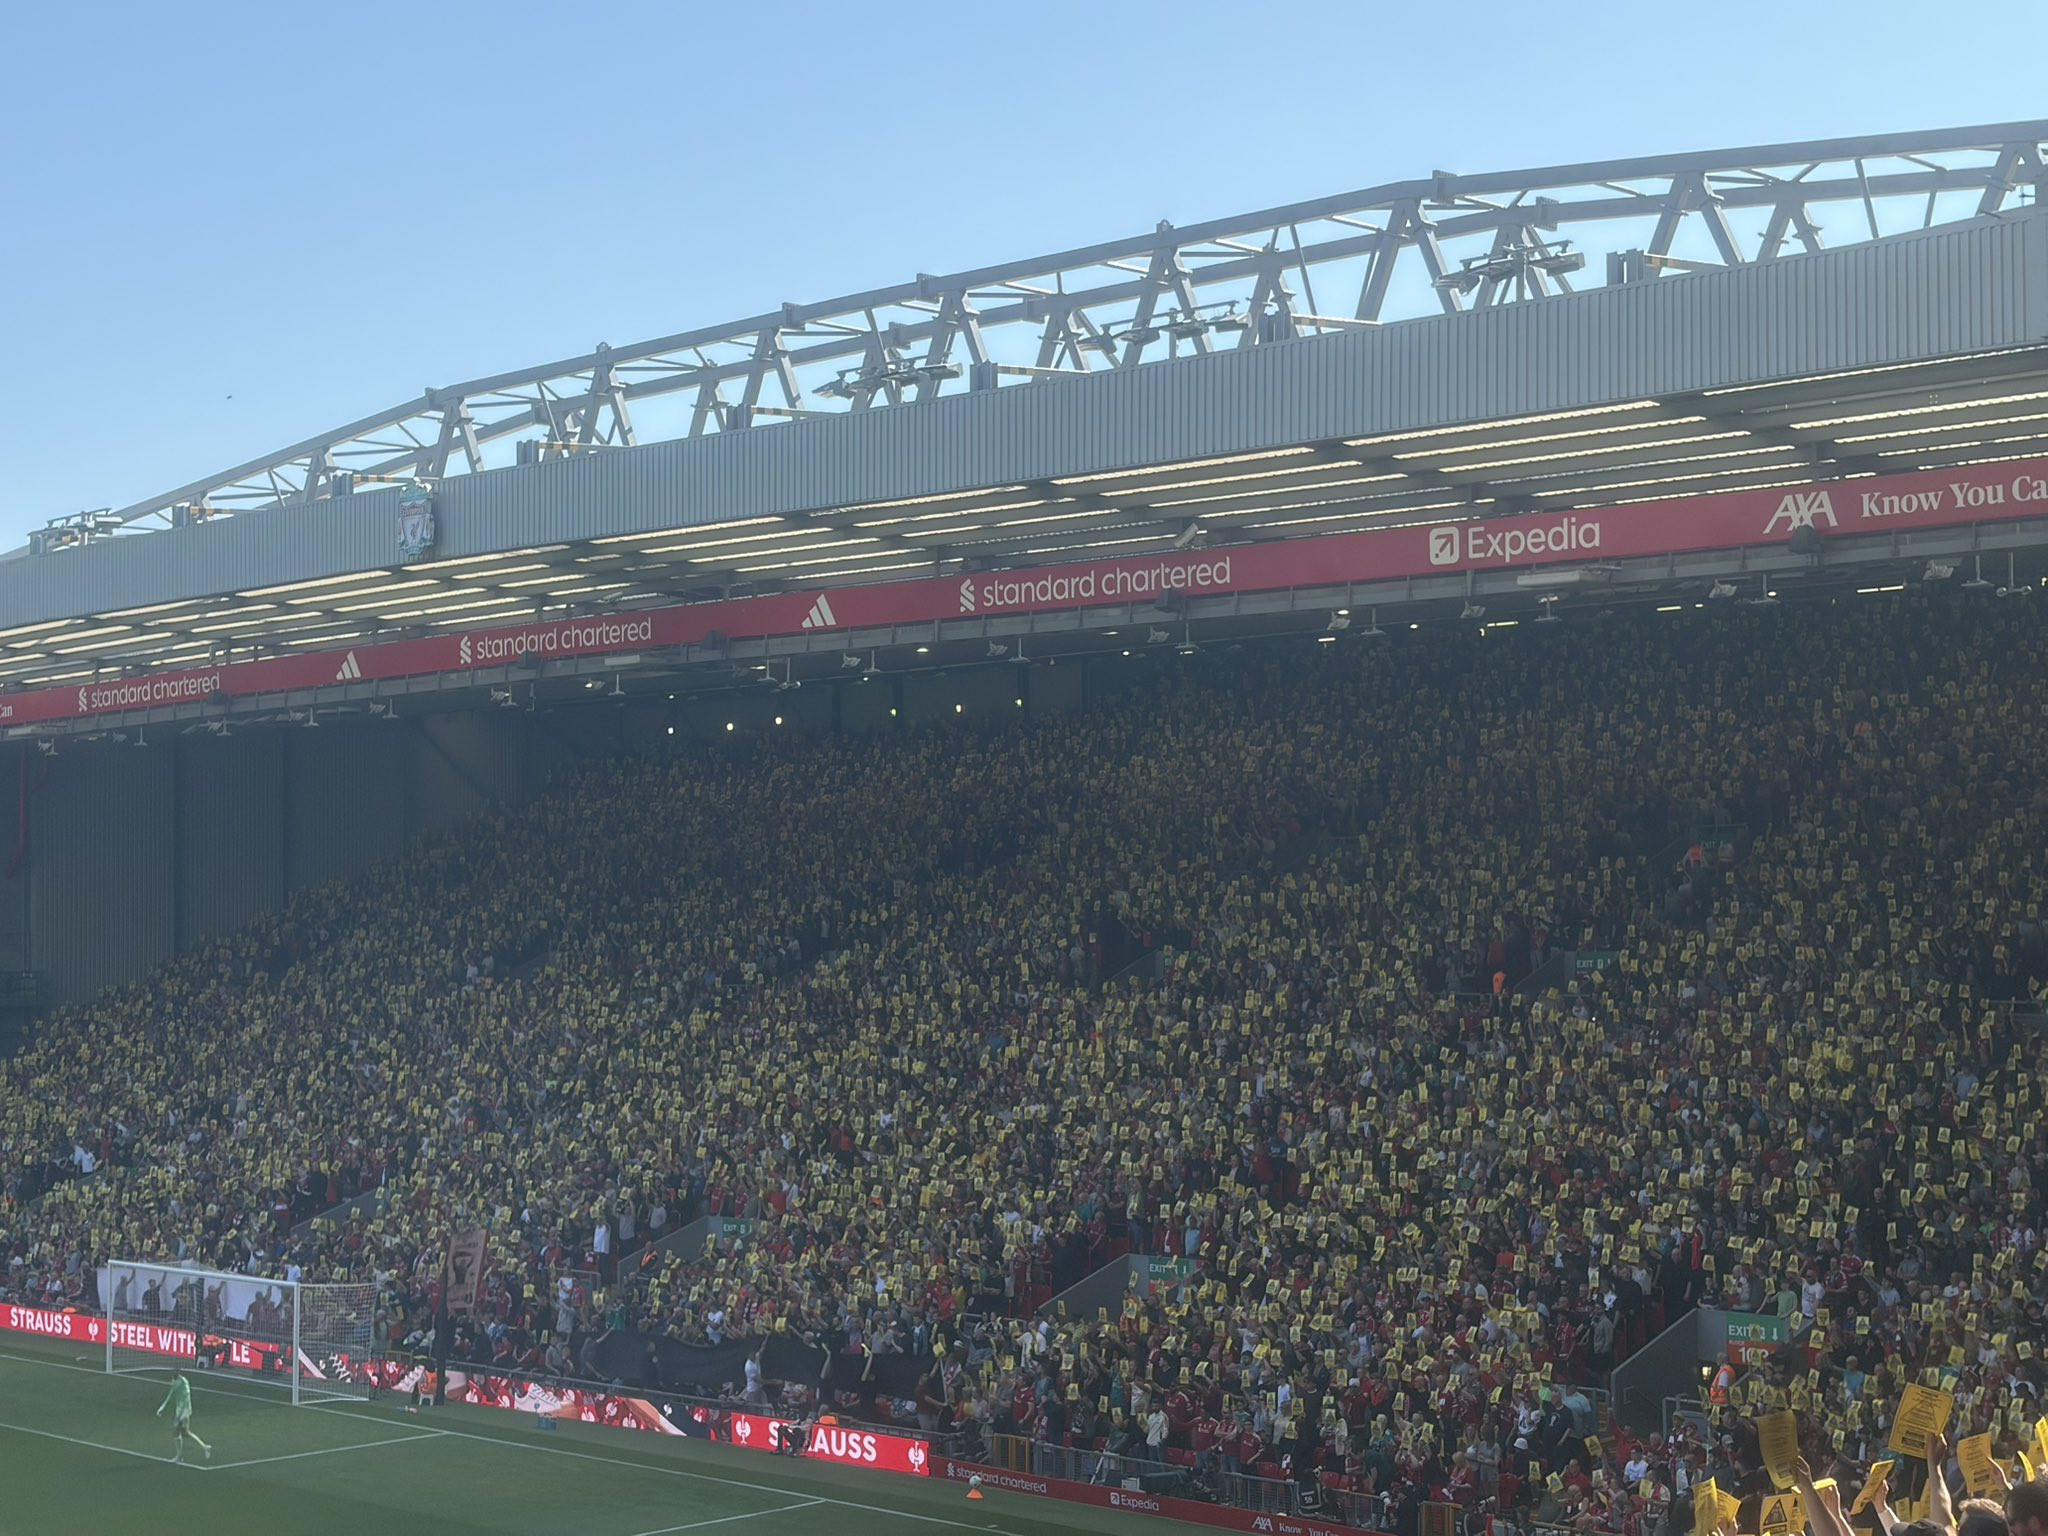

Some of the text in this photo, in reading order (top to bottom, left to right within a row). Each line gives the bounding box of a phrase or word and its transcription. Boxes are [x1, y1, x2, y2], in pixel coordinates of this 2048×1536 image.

[1763, 476, 2048, 535] AXA Know You Ca
[1468, 517, 1600, 563] Expedia
[983, 556, 1231, 607] standard chartered
[477, 617, 652, 660] standard chartered
[91, 672, 220, 708] standard chartered
[1576, 959, 1593, 969] EXIT
[1149, 1263, 1168, 1273] EXIT
[10, 1306, 71, 1336] STRAUSS
[111, 1322, 154, 1349] STEEL
[157, 1329, 197, 1356] WITH
[1000, 1476, 1047, 1493] chartered
[1121, 1494, 1160, 1511] Expedia
[1252, 1516, 1273, 1532] AXA
[1279, 1522, 1303, 1535] Know
